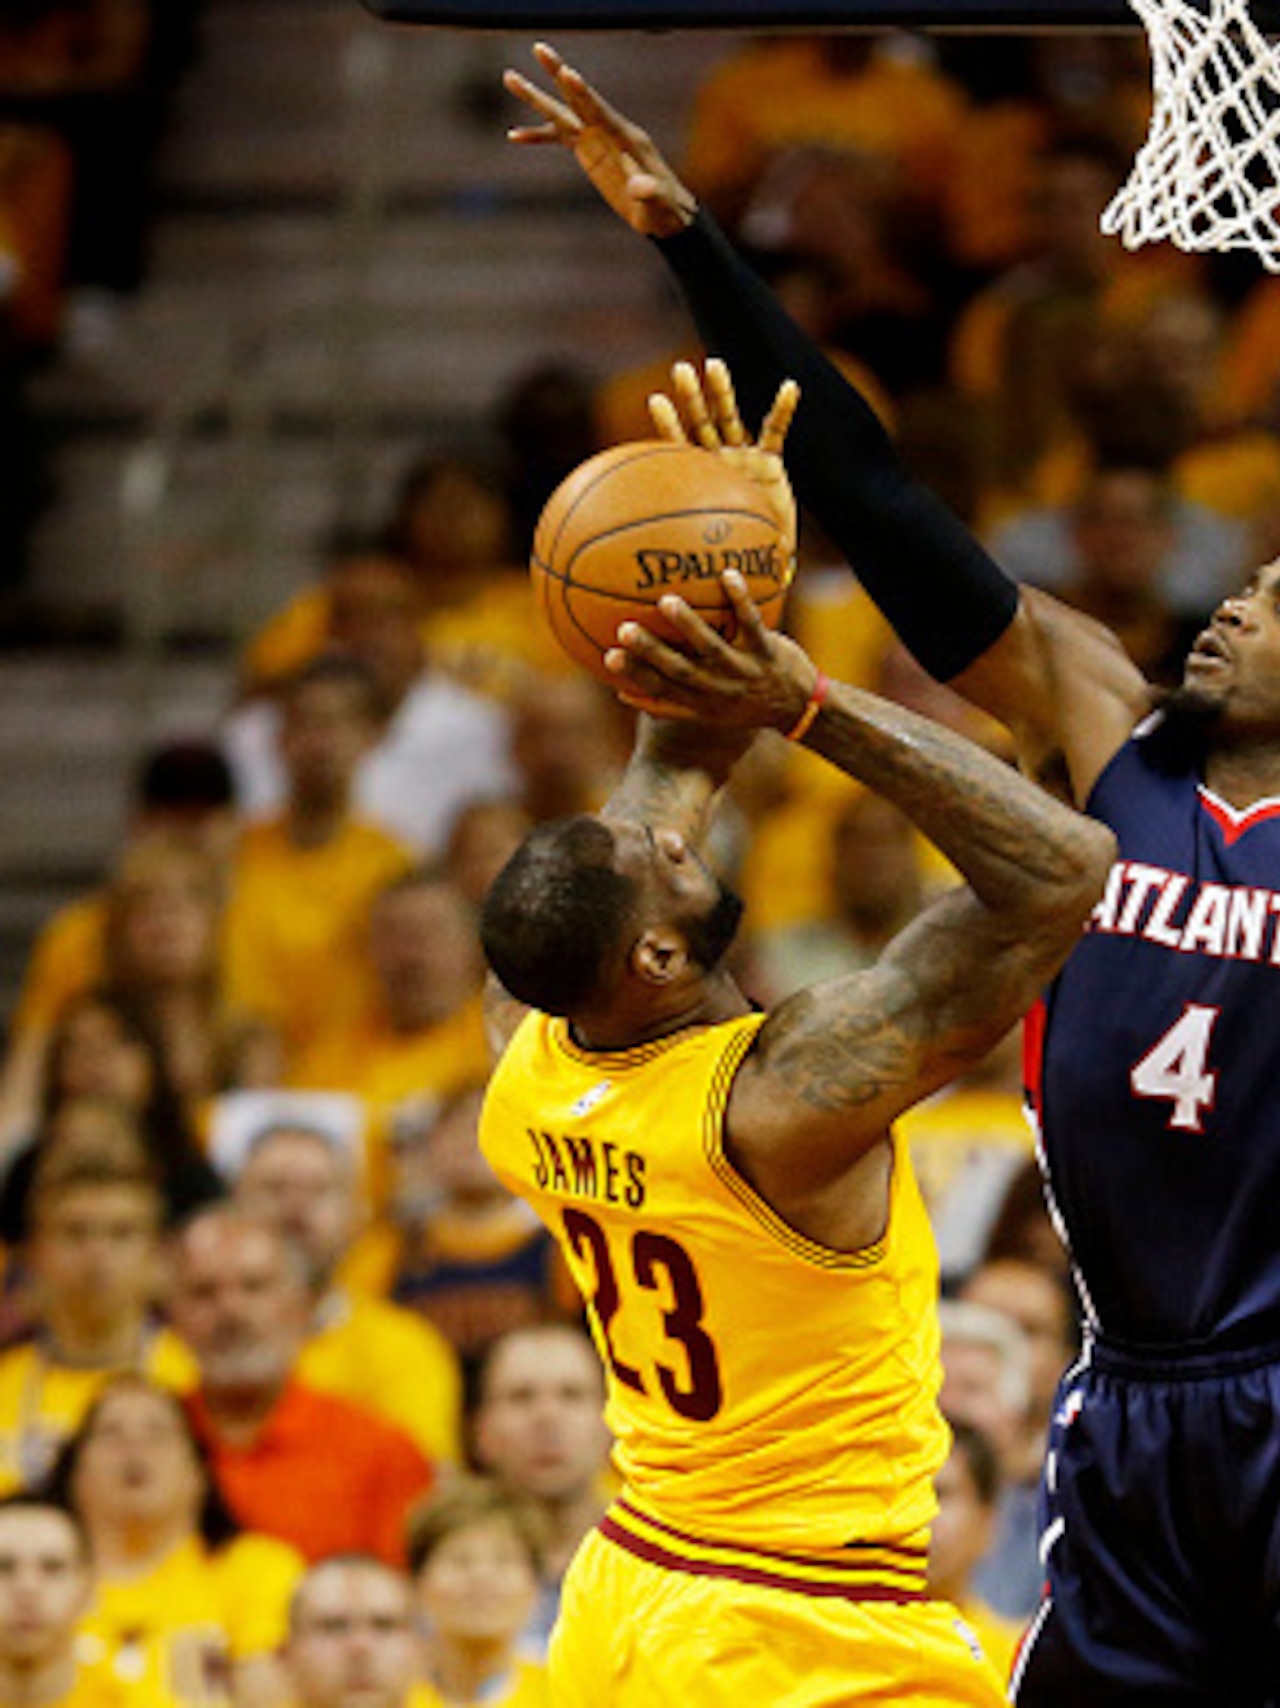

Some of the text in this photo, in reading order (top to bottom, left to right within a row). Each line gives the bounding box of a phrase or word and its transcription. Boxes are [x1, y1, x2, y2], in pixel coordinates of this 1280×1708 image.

[1129, 1001, 1222, 1133] 4
[526, 1127, 646, 1210] JAMES
[560, 1207, 724, 1422] 23
